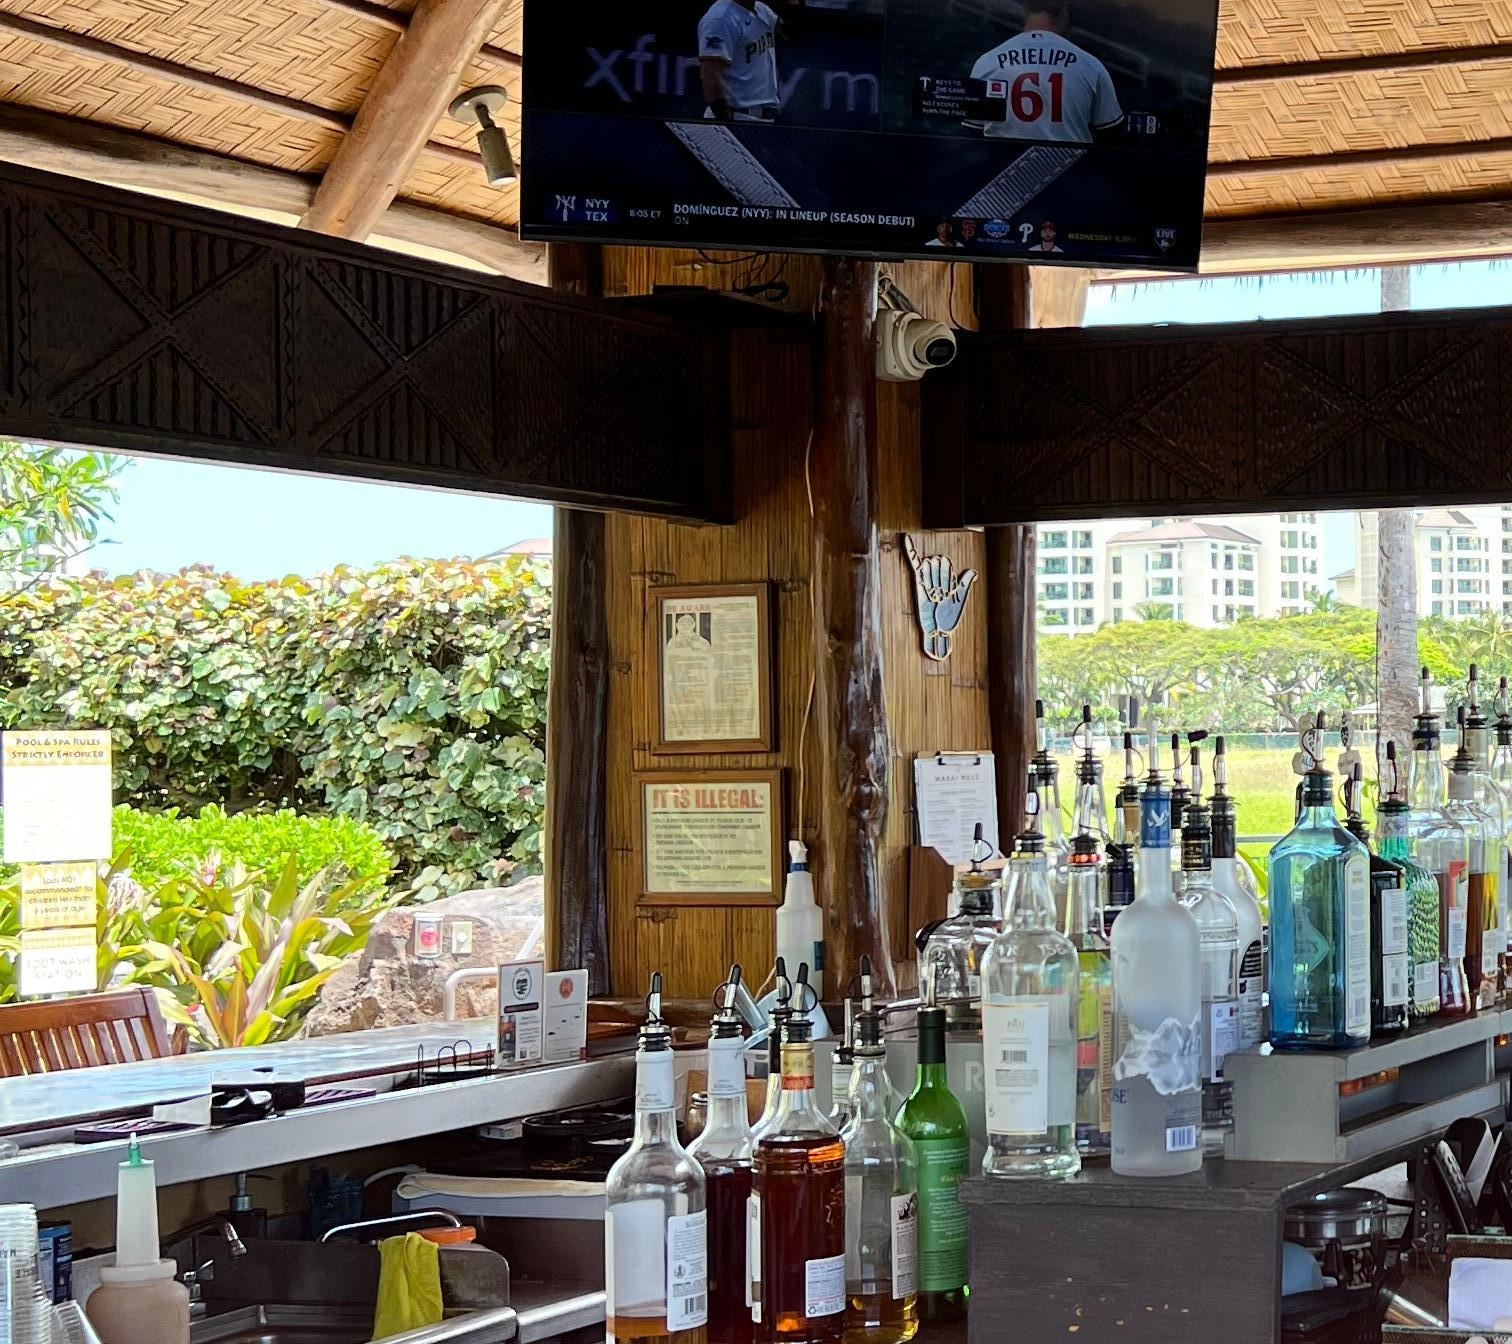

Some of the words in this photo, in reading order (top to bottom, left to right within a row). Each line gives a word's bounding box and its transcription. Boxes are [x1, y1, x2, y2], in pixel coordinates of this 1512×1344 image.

[997, 47, 1078, 69] PRIELIPP
[1010, 72, 1064, 123] 61
[585, 198, 611, 210] NYY
[585, 210, 608, 223] TEX
[741, 207, 773, 220] (NYY):
[775, 209, 788, 220] IN
[789, 210, 828, 222] LINEUP
[829, 212, 876, 224] (SEASON
[877, 215, 915, 227] DEBUT)
[15, 737, 44, 746] POOL
[53, 737, 71, 747] SPA
[73, 736, 102, 746] RULES
[653, 789, 668, 809] IT
[672, 788, 691, 809] IS
